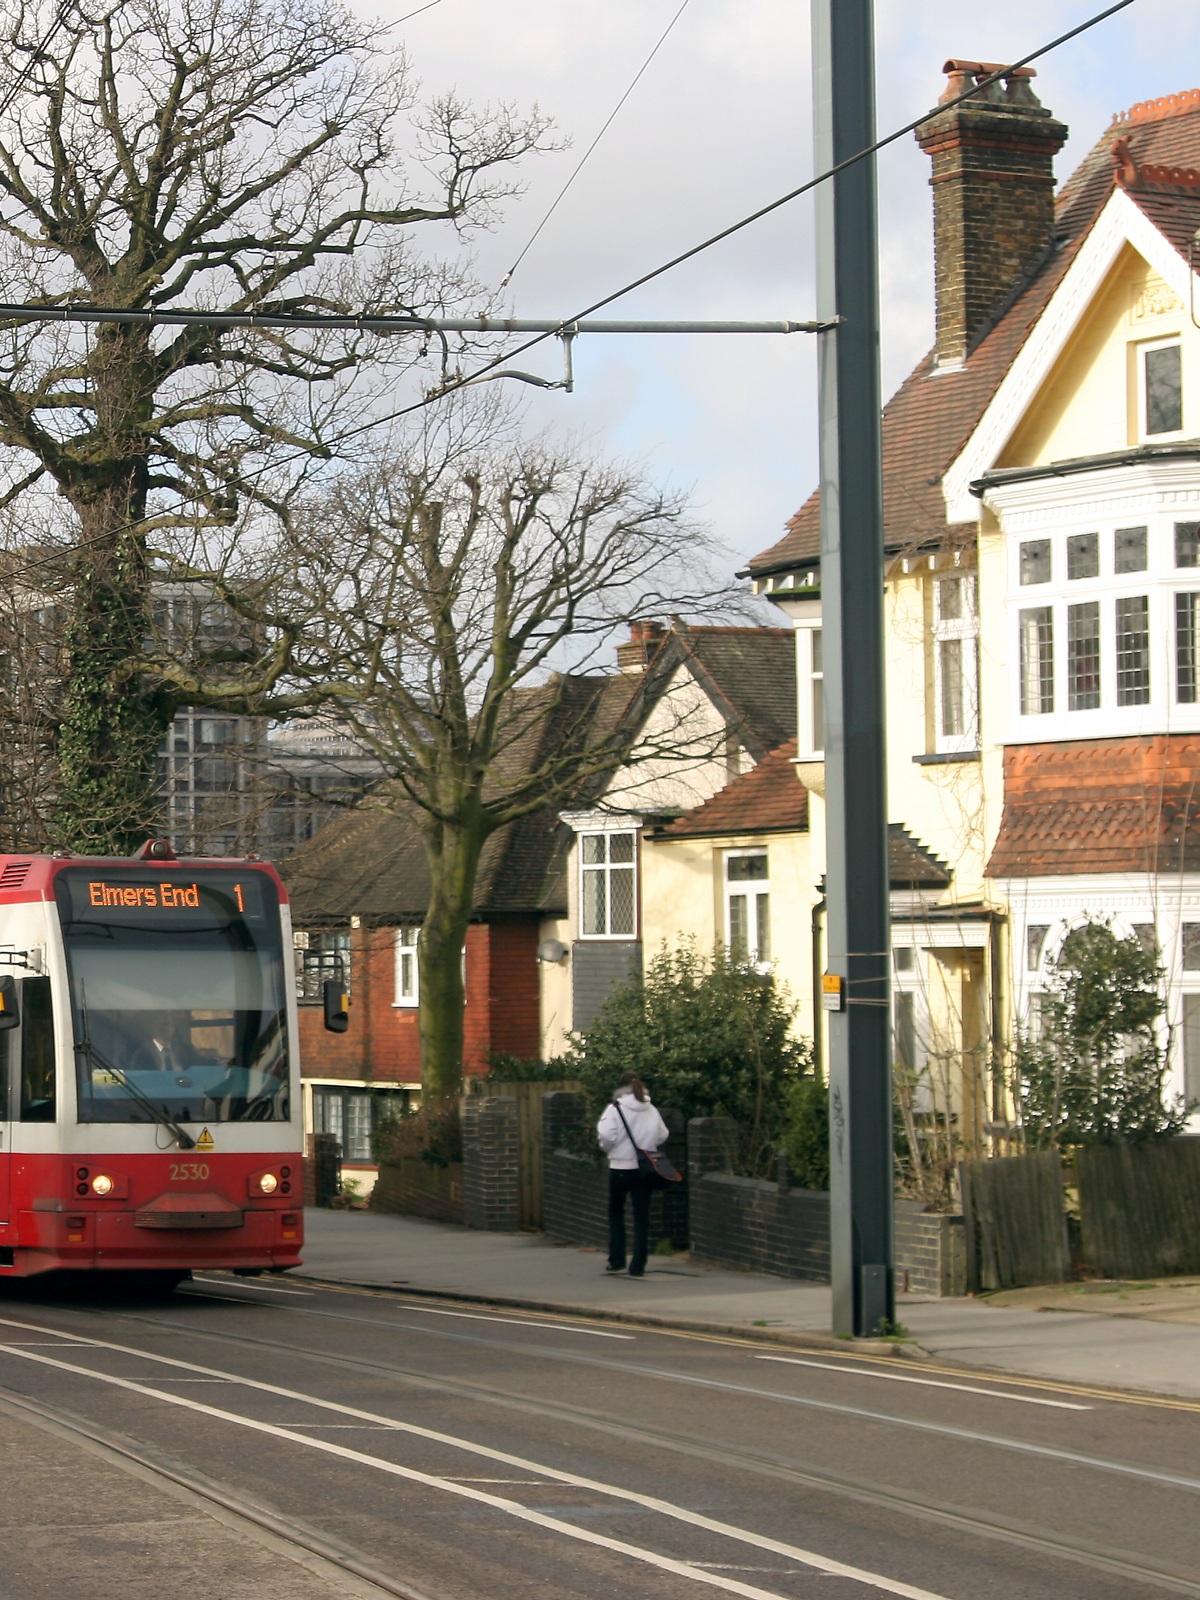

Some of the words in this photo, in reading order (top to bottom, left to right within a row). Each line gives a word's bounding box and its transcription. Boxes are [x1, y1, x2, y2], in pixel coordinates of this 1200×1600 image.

[89, 882, 157, 907] Elmers
[159, 883, 200, 907] End
[233, 884, 245, 913] 1
[169, 1163, 210, 1181] 2530
